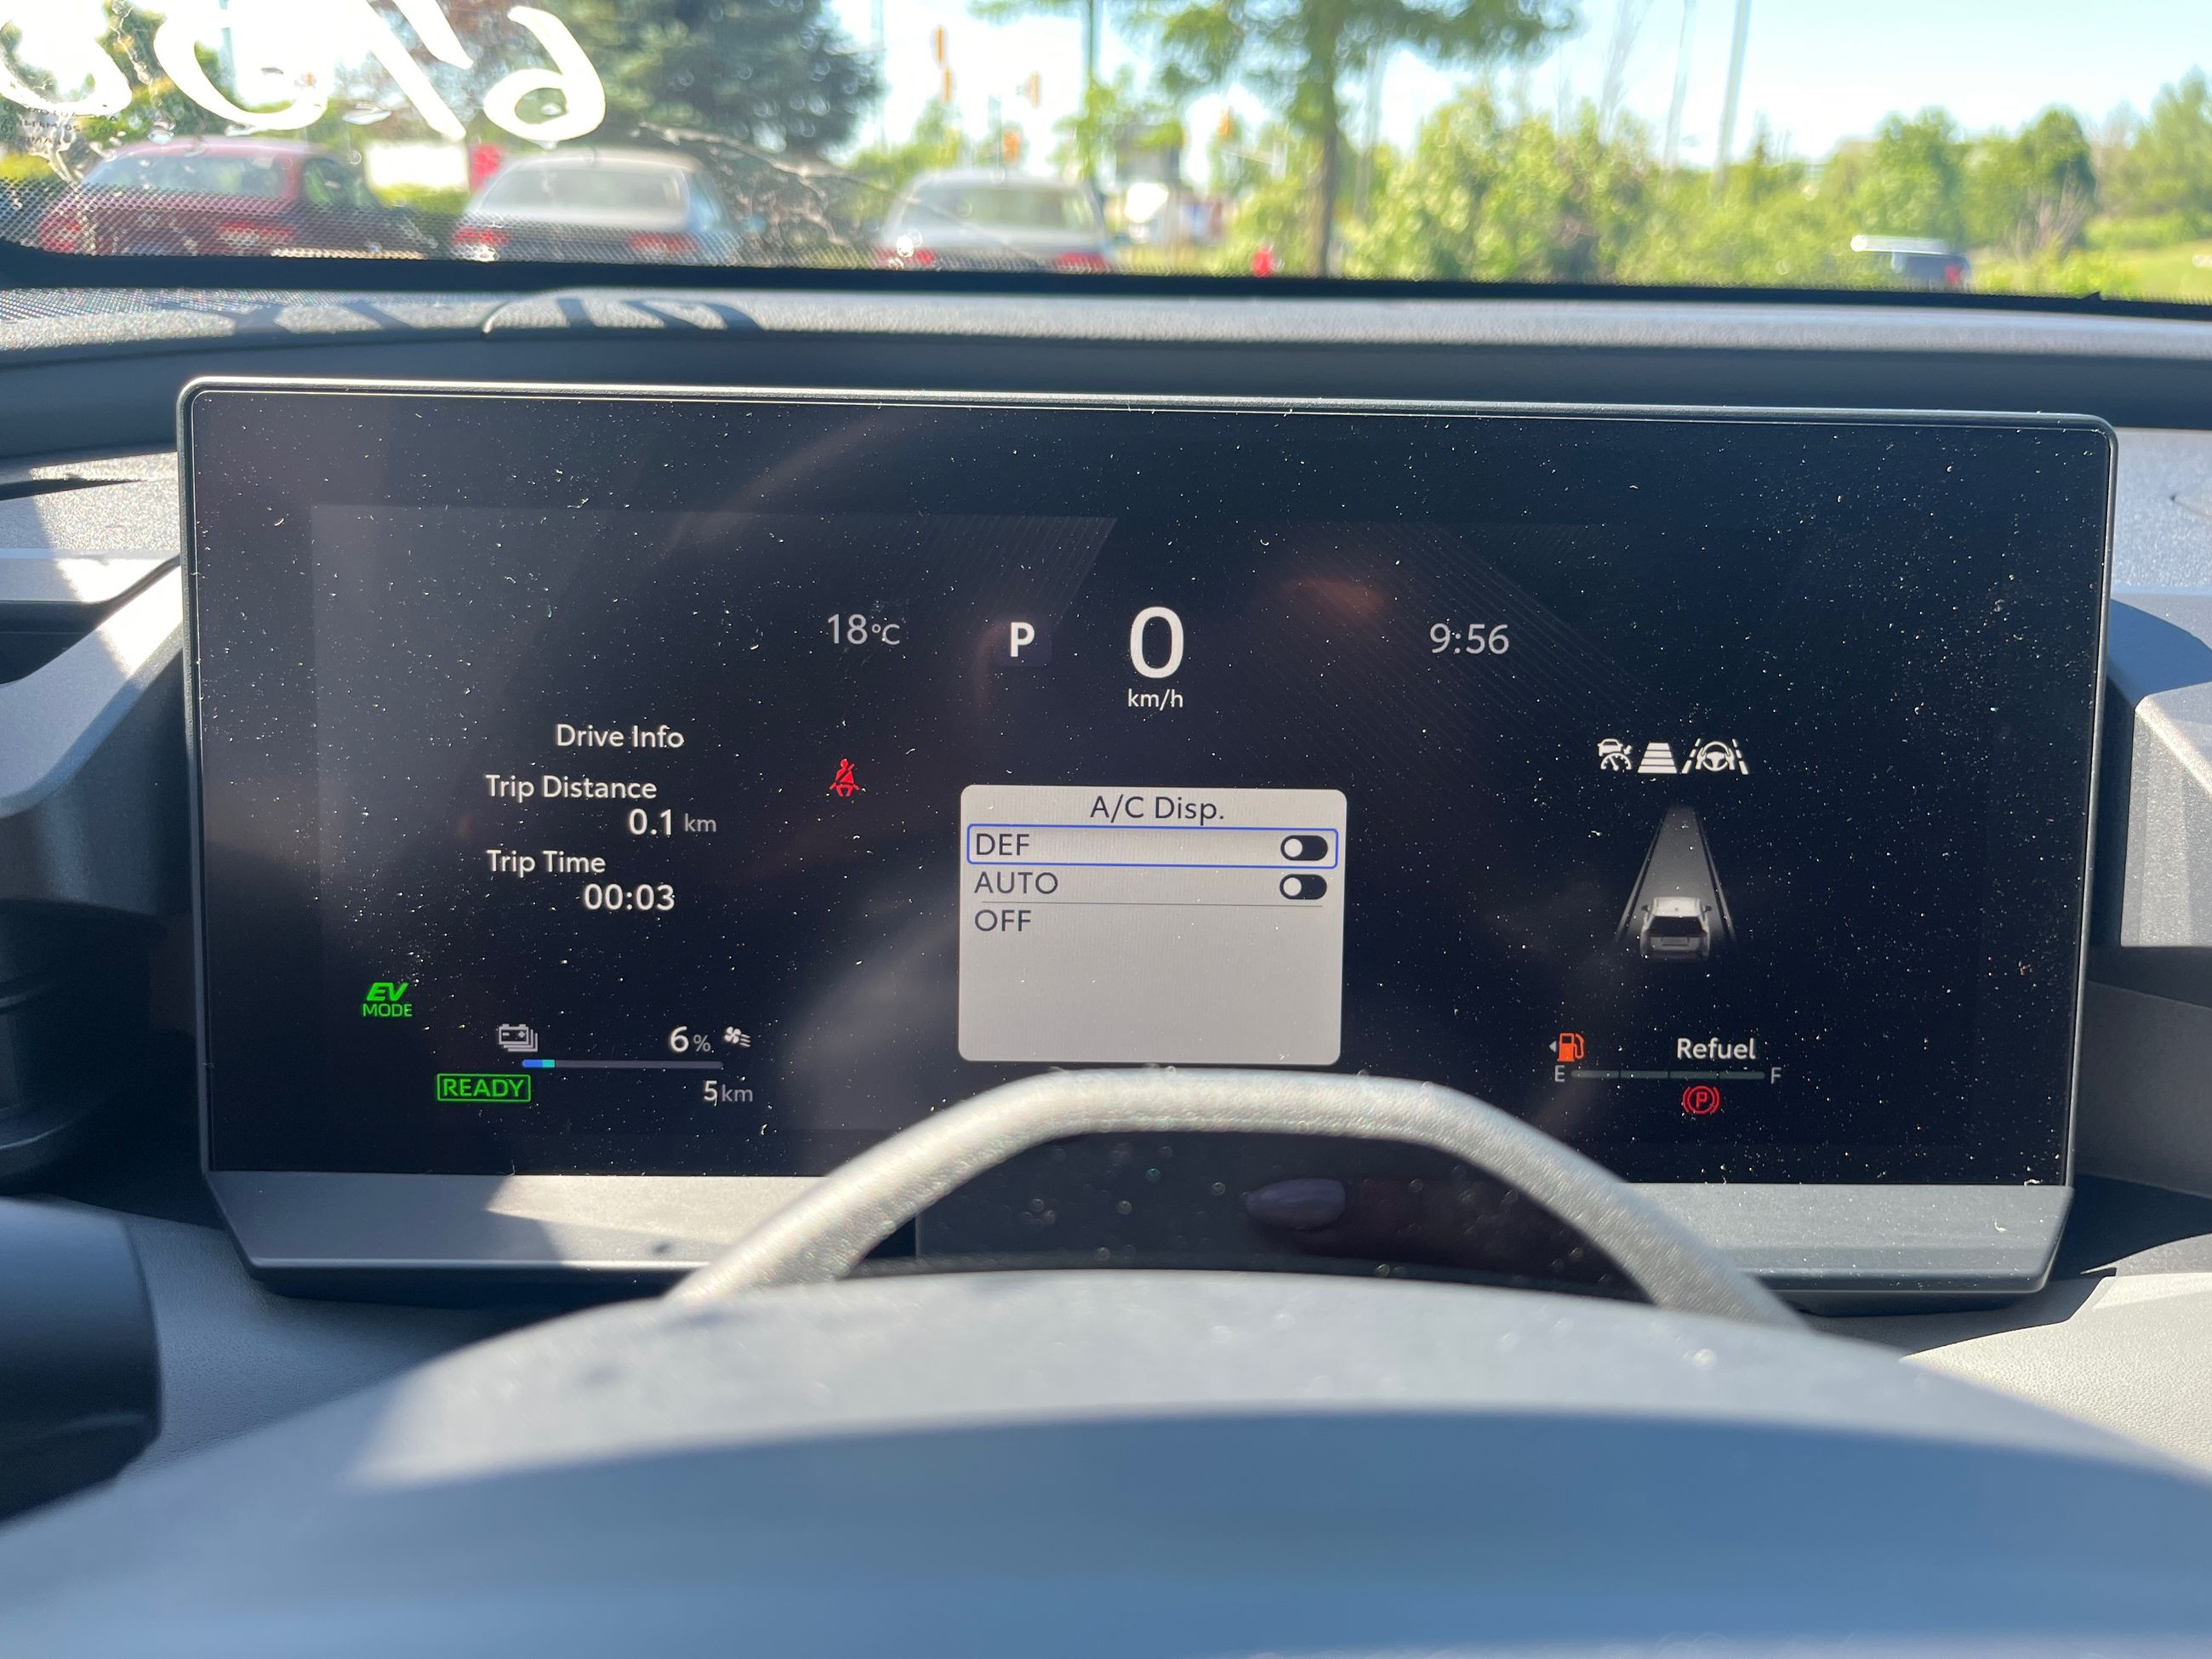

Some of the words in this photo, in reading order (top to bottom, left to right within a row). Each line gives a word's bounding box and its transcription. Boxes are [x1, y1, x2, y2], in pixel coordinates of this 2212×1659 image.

[1010, 621, 1035, 658] P
[1130, 606, 1184, 679] 0
[1429, 623, 1509, 654] 9:56
[1127, 687, 1183, 711] km/h
[556, 723, 624, 747] Drive
[631, 724, 685, 749] Info
[485, 774, 535, 804] Trip
[543, 774, 658, 799] Distance
[629, 808, 671, 835] 0.1
[684, 812, 717, 833] km
[1090, 794, 1144, 824] A/C
[1154, 795, 1224, 826] Disp.
[976, 833, 1030, 856] DEF
[486, 849, 536, 878] Trip
[542, 850, 606, 873] Time
[973, 870, 1058, 895] AUTO
[584, 883, 675, 911] 00:03
[974, 909, 1032, 932] OFF
[366, 982, 409, 1002] EV
[362, 1003, 413, 1018] MODE
[1677, 1037, 1756, 1060] Refuel
[1554, 1064, 1565, 1083] E
[1770, 1066, 1782, 1085] F
[443, 1078, 525, 1097] READY
